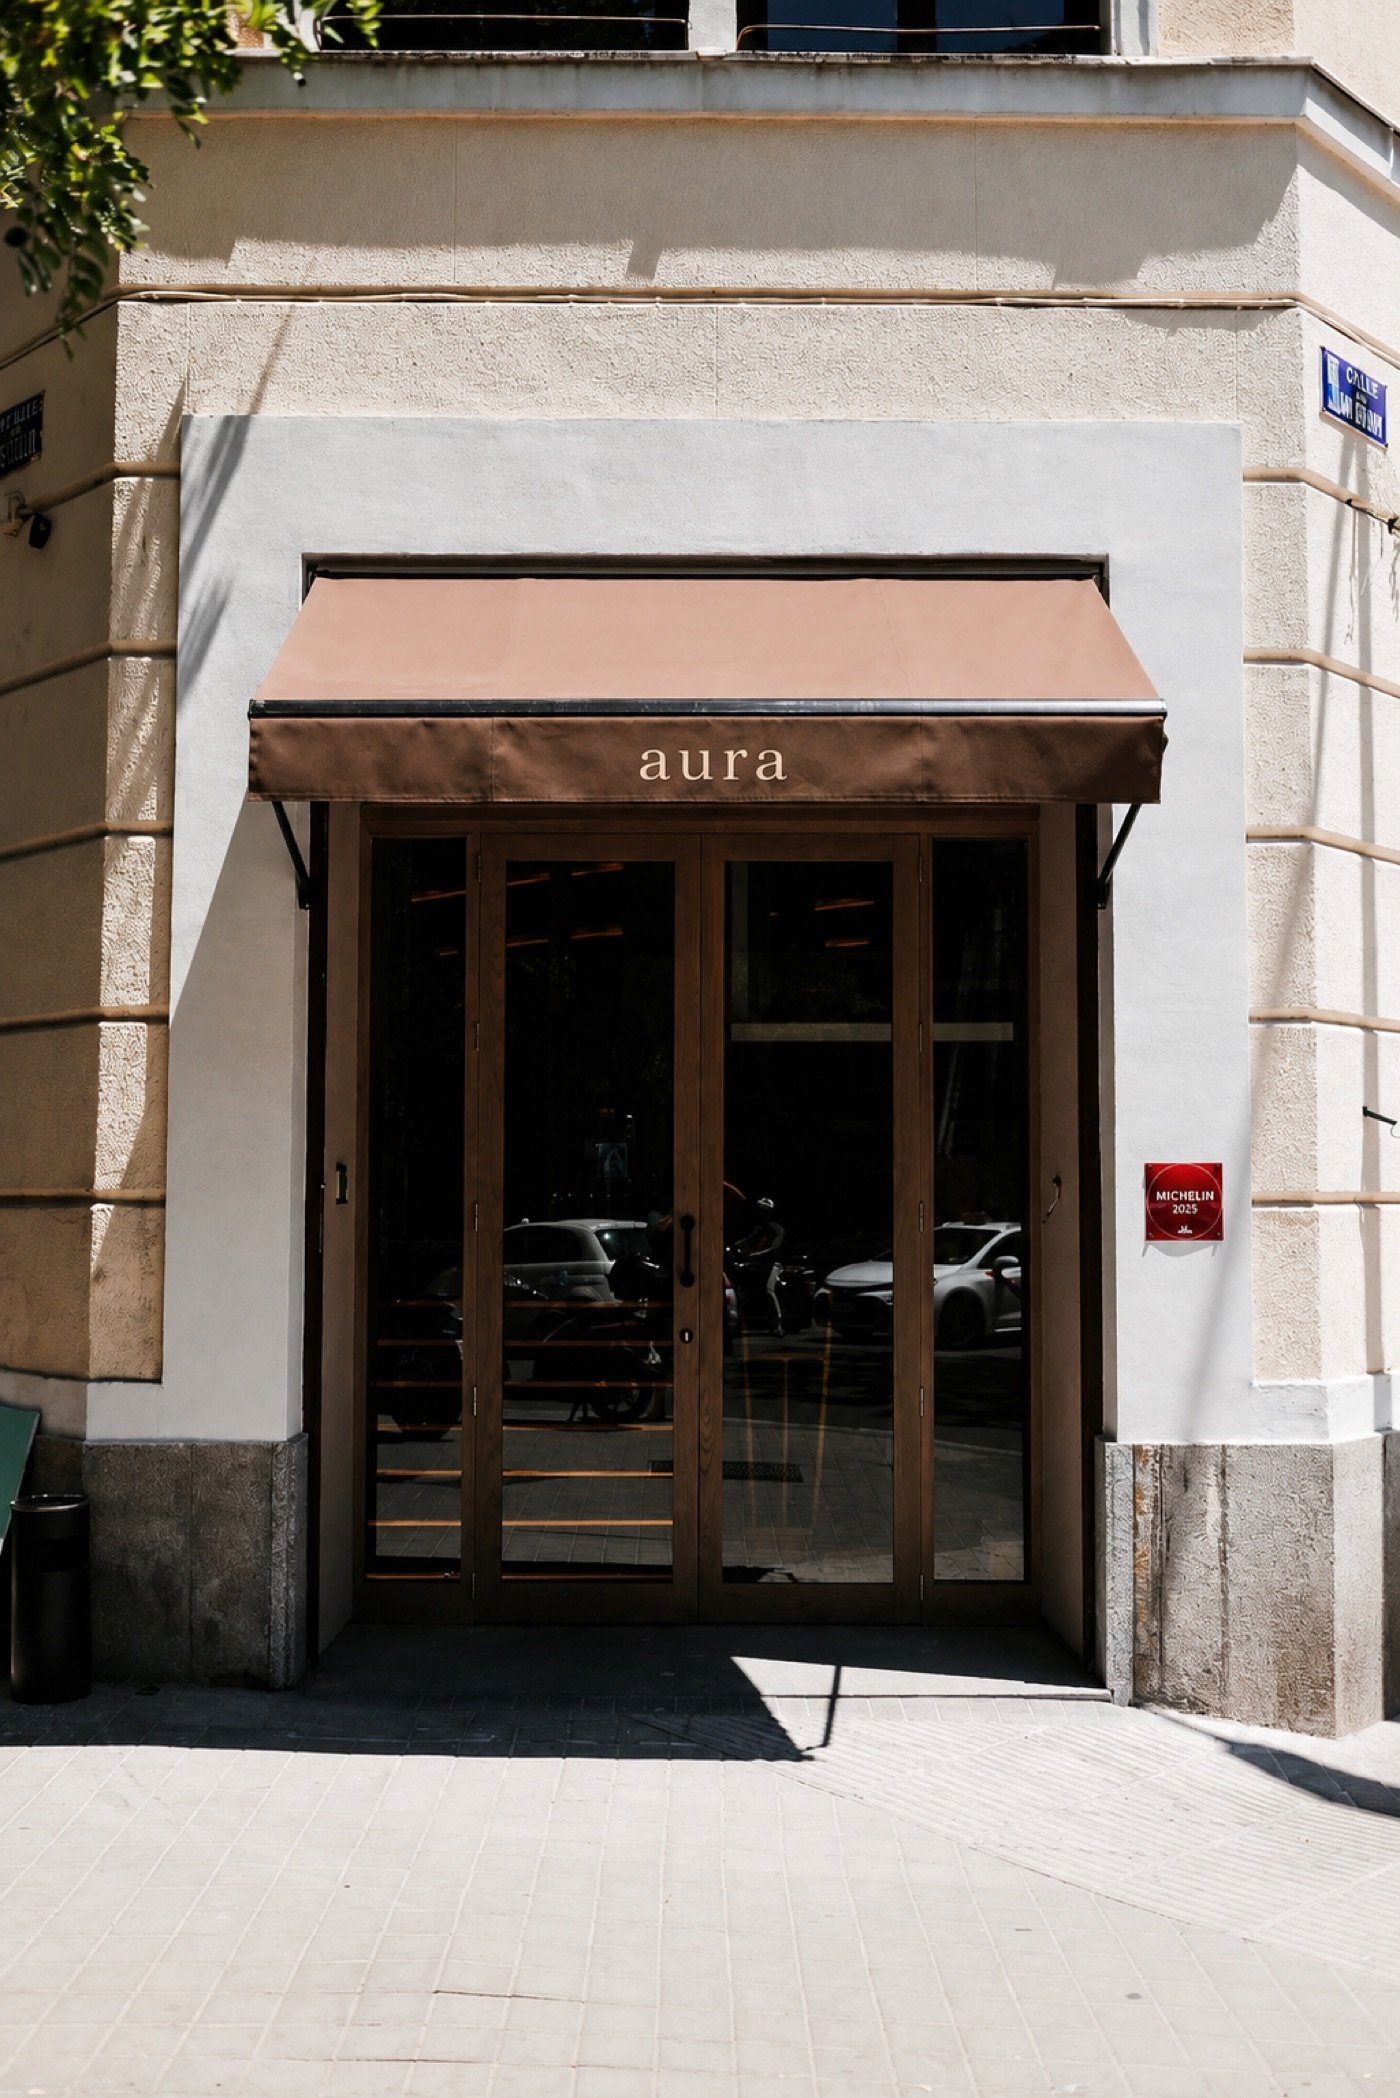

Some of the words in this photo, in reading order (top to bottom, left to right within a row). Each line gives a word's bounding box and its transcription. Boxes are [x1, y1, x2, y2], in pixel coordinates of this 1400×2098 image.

[1346, 367, 1379, 400] CALLE
[639, 748, 788, 781] aura
[1156, 1190, 1214, 1201] MICHELIN
[1172, 1203, 1199, 1215] 2025
